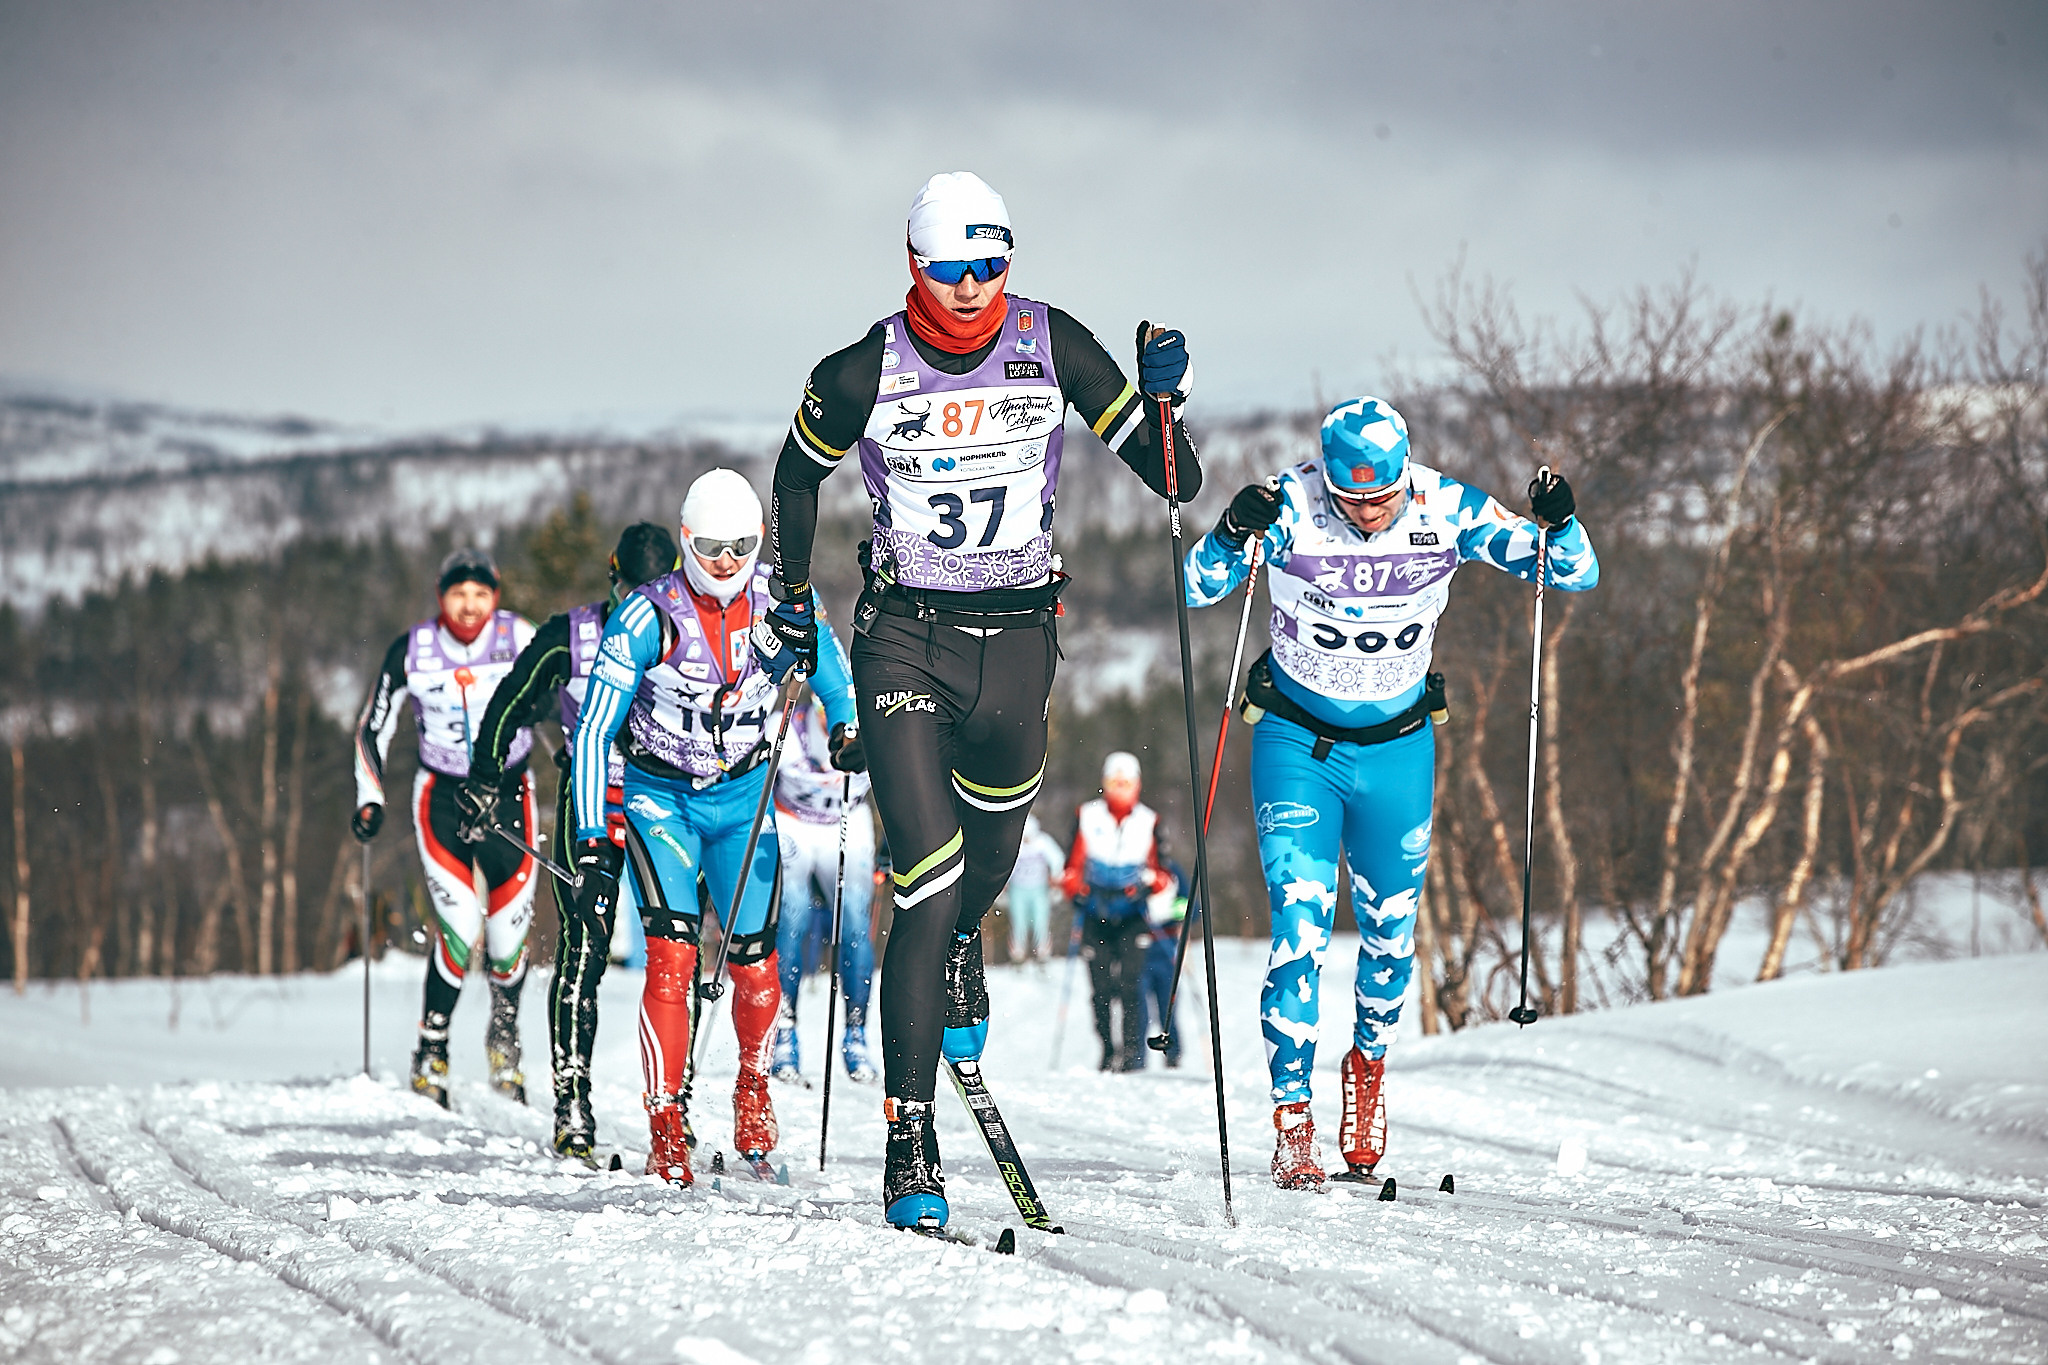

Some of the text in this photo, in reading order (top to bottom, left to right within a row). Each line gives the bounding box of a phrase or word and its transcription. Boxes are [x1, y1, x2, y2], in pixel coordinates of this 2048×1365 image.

[941, 400, 985, 438] 87
[960, 451, 1007, 462] НОРНИКЕЛЬ
[927, 486, 1008, 550] 37
[1352, 561, 1393, 593] 87
[602, 639, 637, 670] adidas
[875, 690, 937, 713] RUN LAB
[998, 1161, 1038, 1216] FISCHER
